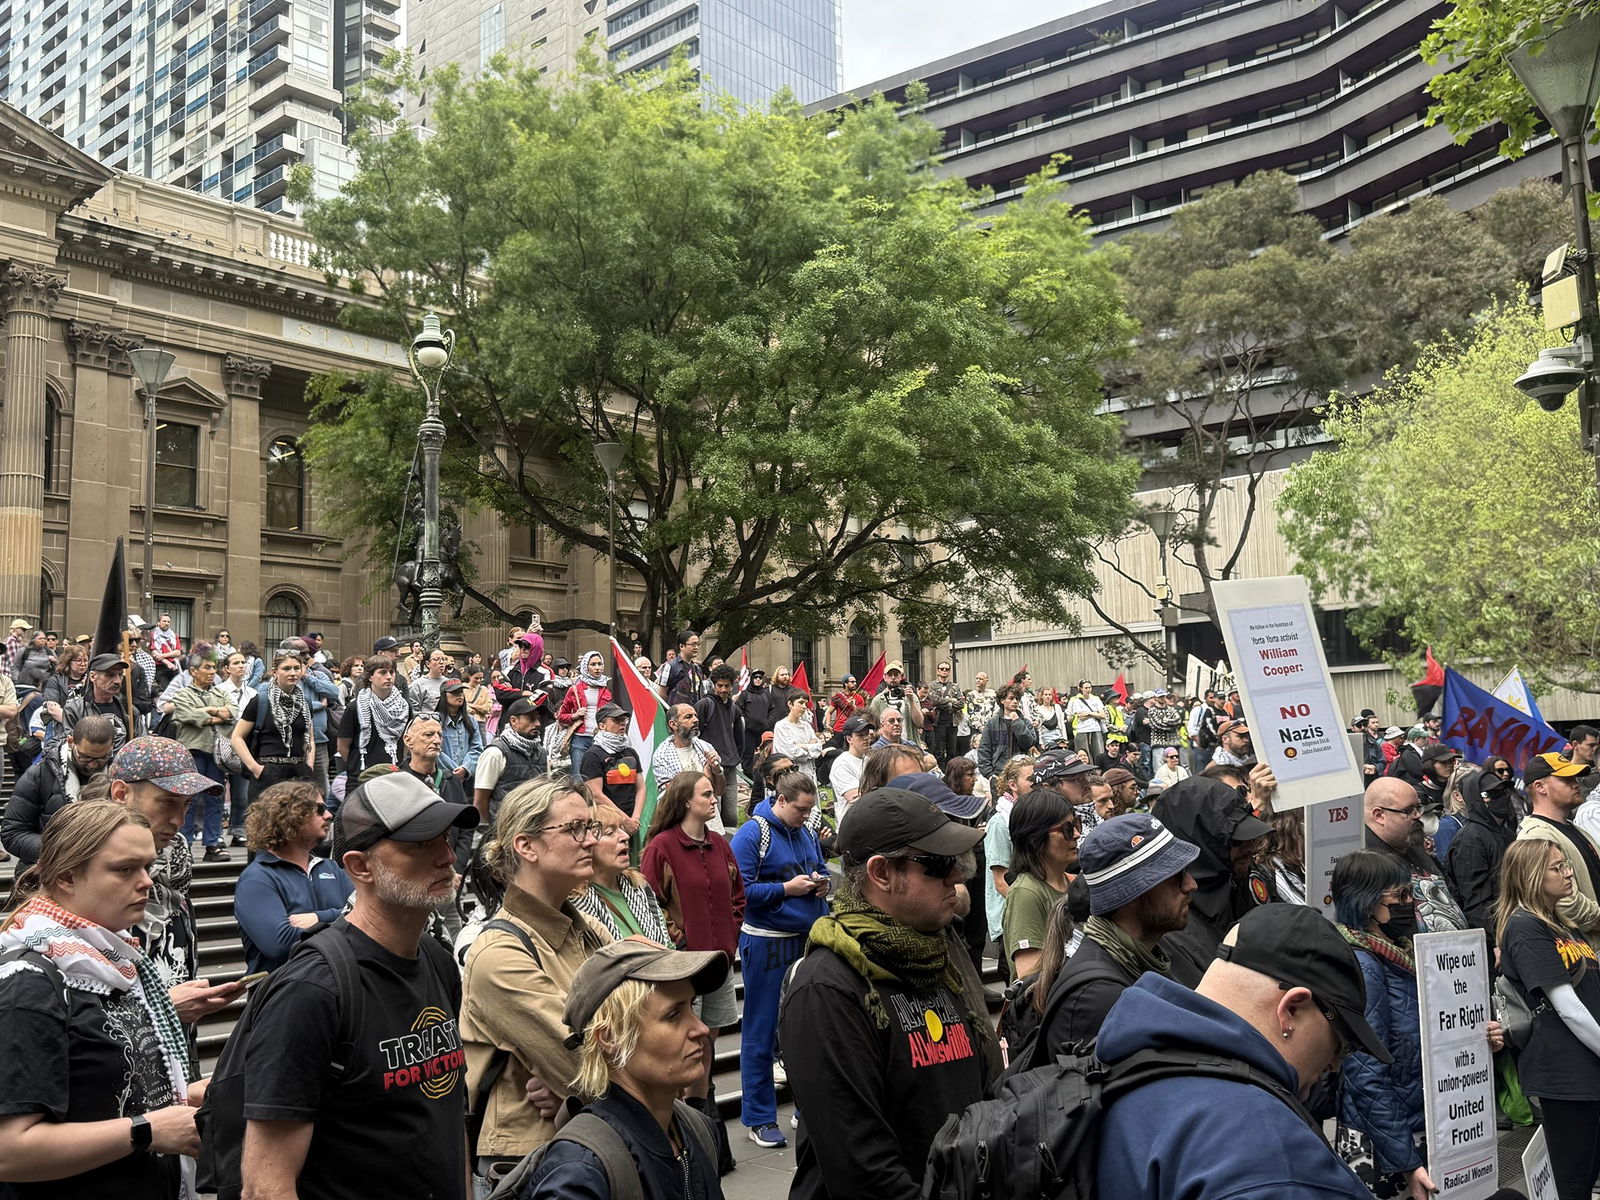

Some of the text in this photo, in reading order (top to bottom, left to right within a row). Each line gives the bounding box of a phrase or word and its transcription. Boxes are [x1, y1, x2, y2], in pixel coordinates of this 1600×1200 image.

[298, 324, 396, 358] STATE
[1251, 633, 1299, 646] Yorta Yorta activist
[1259, 648, 1298, 660] William
[1263, 663, 1304, 677] Cooper:
[1279, 703, 1311, 720] NO
[1279, 724, 1324, 744] Nazis
[1328, 806, 1349, 823] YES
[1436, 951, 1476, 972] Wipe out
[1453, 979, 1468, 995] the
[1439, 1006, 1485, 1032] Far Right
[1454, 1050, 1476, 1069] with a
[383, 1065, 421, 1090] FOR
[1437, 1065, 1489, 1094] union-powered
[1448, 1096, 1485, 1121] United
[1451, 1121, 1484, 1146] Front!
[1443, 1163, 1493, 1191] Radical Women
